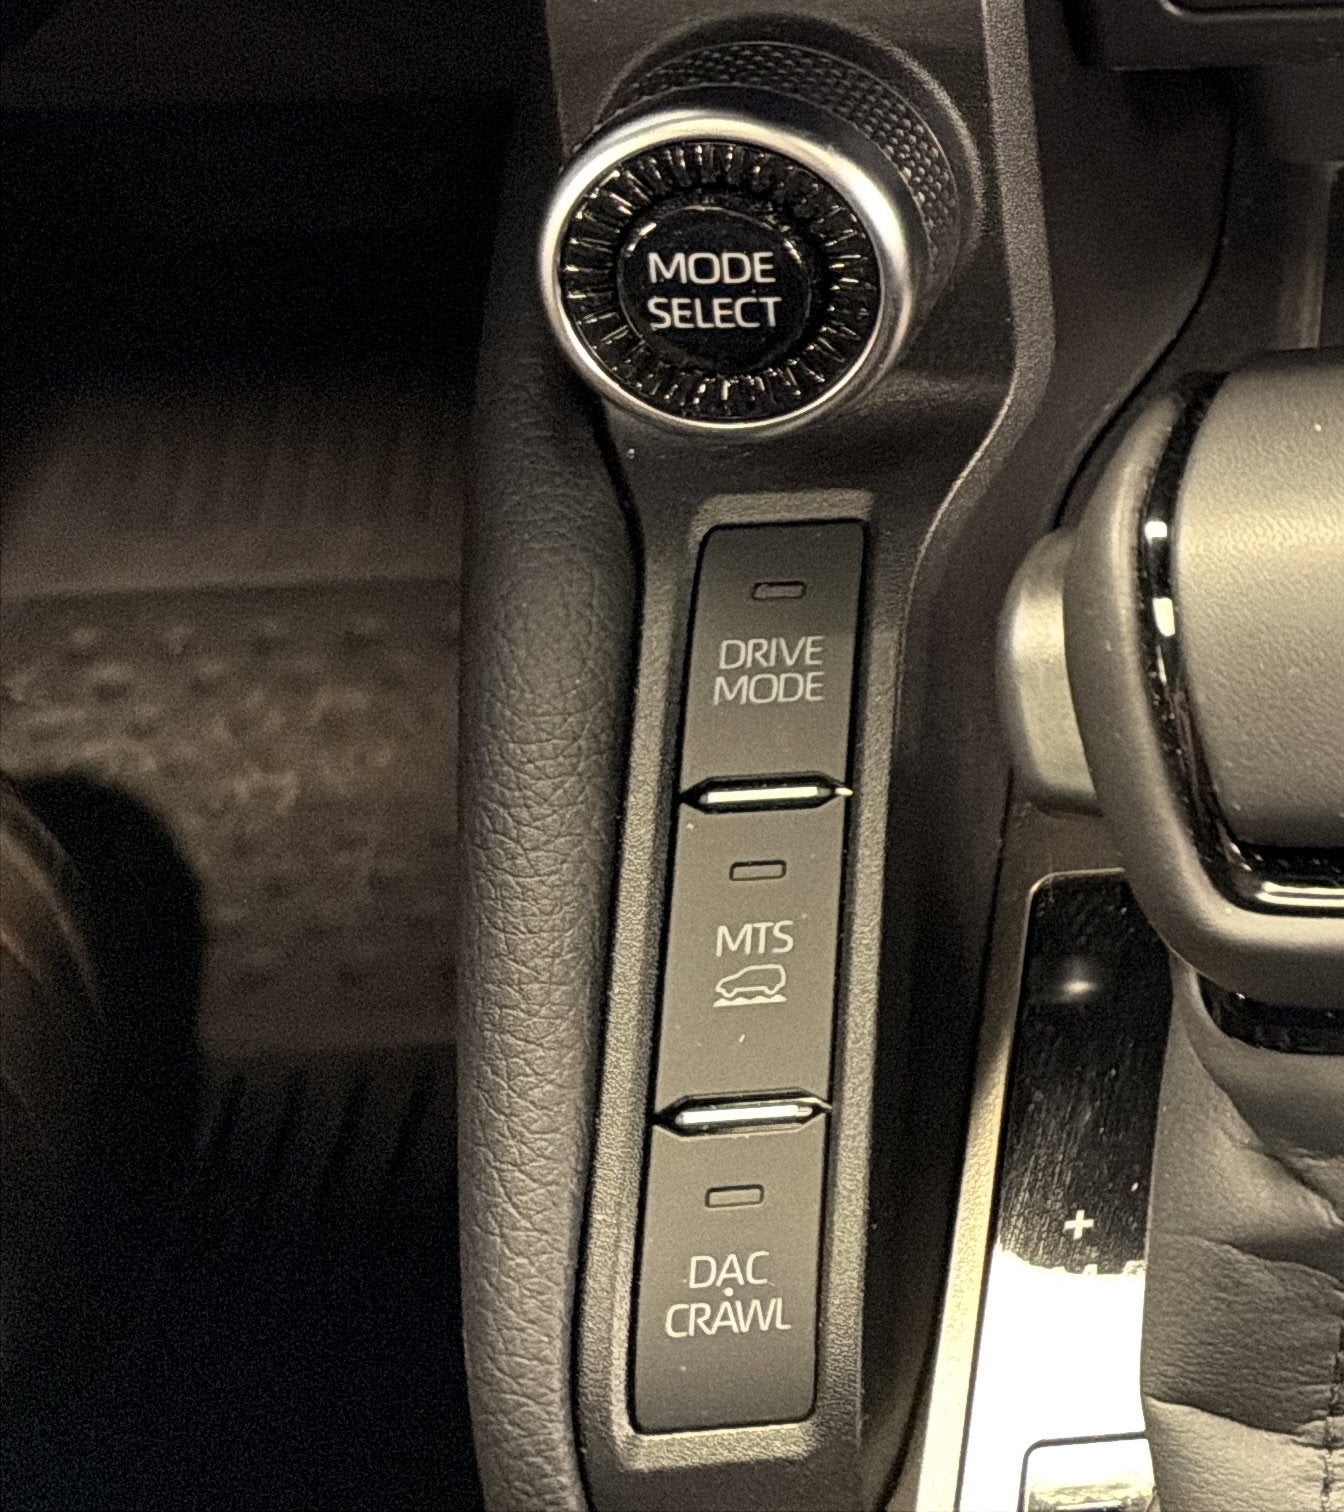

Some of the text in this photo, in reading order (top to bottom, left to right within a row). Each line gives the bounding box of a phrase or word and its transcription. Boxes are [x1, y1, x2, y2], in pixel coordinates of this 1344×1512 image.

[647, 250, 777, 285] MODE
[646, 295, 782, 331] SELECT
[718, 635, 824, 670] DRIVE
[712, 670, 825, 706] MODE
[715, 920, 795, 958] MTS
[688, 1250, 770, 1290] DAC
[664, 1296, 792, 1338] CRAWL
